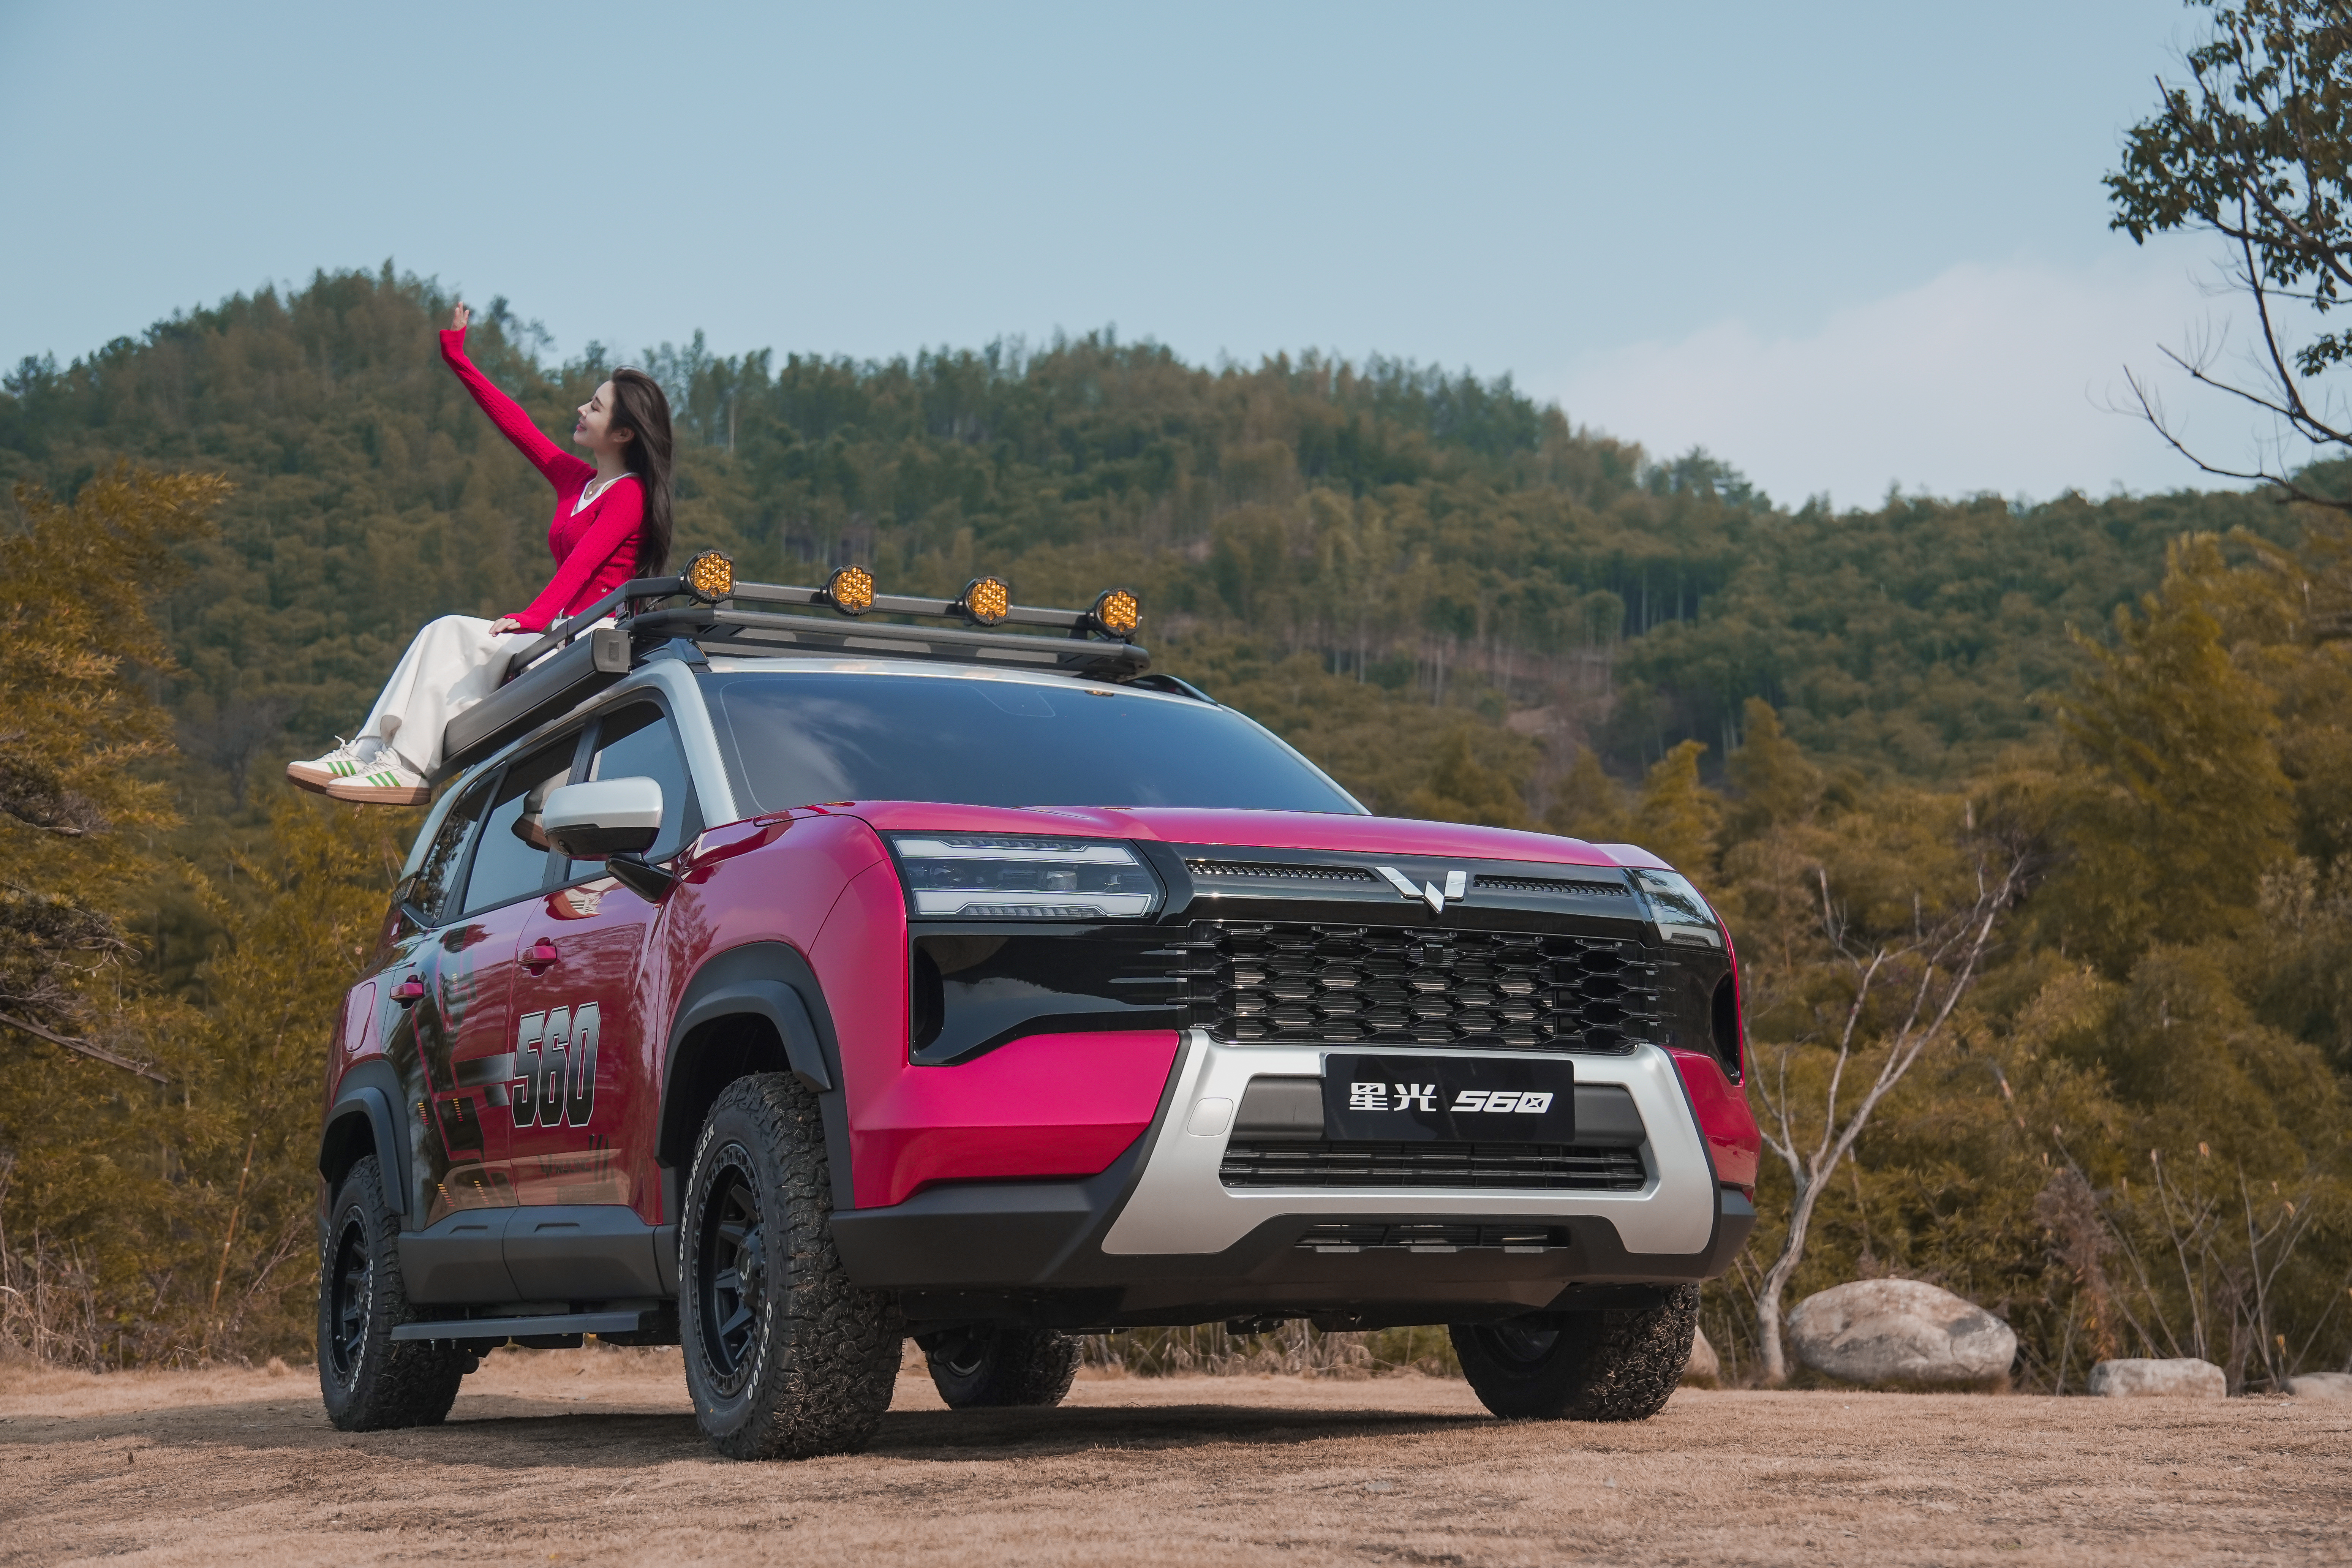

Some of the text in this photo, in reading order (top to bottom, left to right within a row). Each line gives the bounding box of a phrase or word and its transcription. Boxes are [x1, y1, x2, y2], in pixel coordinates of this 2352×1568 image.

[512, 1001, 601, 1128] 560
[1349, 1083, 1554, 1113] 星光 560
[679, 1124, 714, 1282] COMFORSER
[351, 1259, 373, 1393] COMFORSER
[748, 1301, 772, 1400] CF1100
